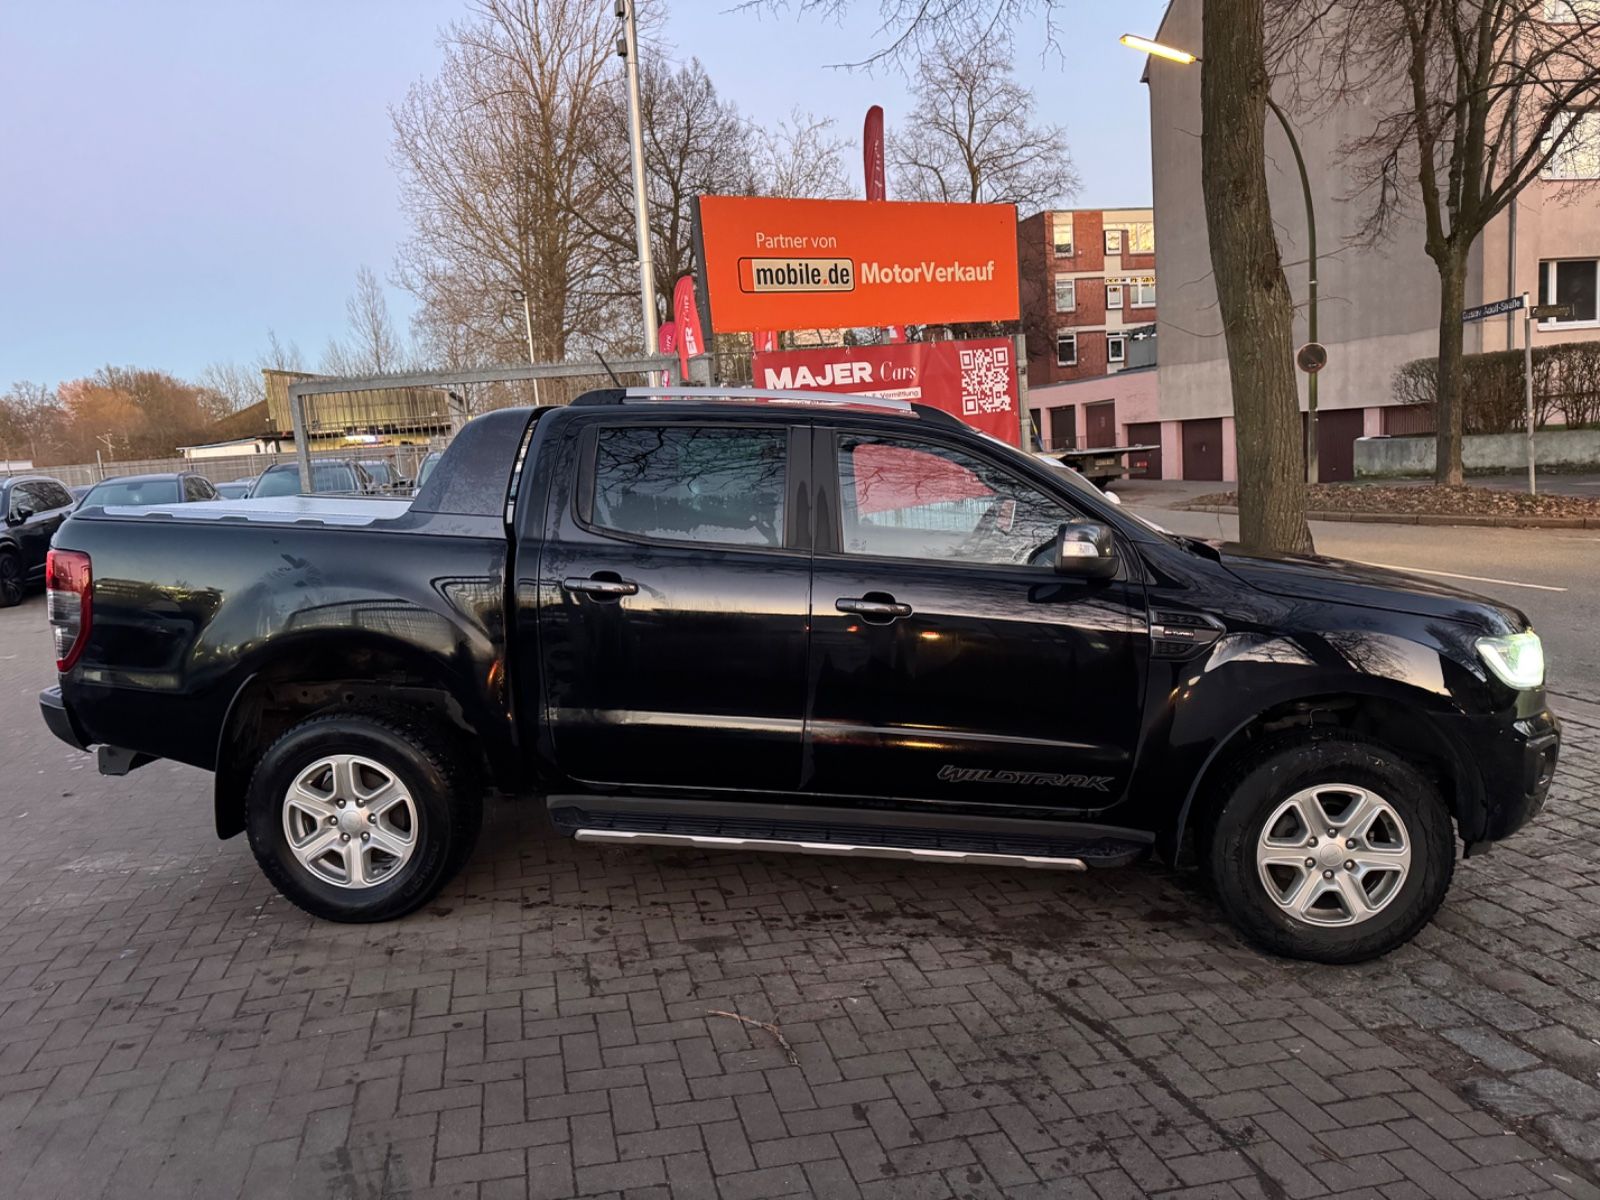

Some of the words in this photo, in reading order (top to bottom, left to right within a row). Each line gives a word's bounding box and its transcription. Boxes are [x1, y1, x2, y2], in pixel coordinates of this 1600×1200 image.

[756, 232, 808, 249] Partner
[811, 236, 837, 249] von
[756, 263, 850, 286] mobile.de
[861, 261, 994, 284] MotorVerkauf
[764, 361, 874, 390] MAJER
[880, 361, 917, 381] Cars
[937, 764, 1115, 792] WILDTRAK
